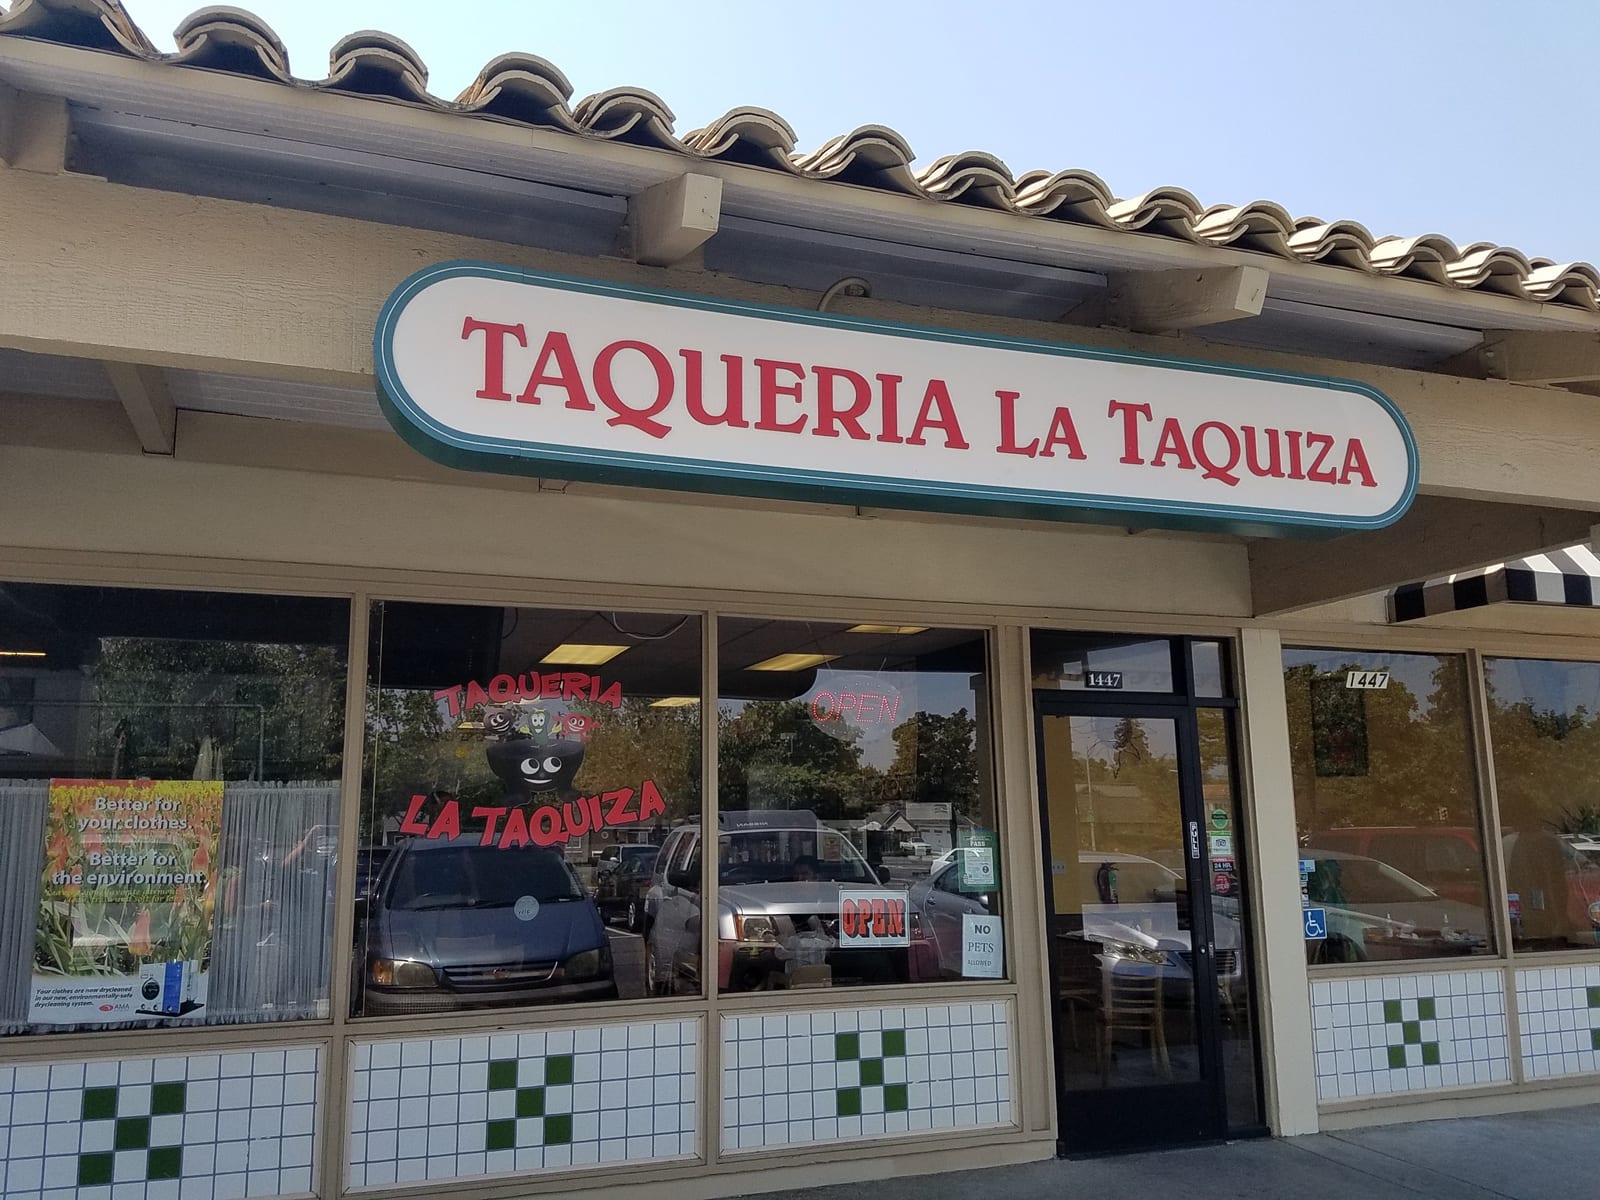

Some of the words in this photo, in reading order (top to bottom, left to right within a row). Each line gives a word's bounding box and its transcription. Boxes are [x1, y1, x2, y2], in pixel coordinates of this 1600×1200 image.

[462, 316, 969, 449] TAQUERIA
[995, 390, 1087, 460] LA
[1107, 400, 1377, 487] TAQUIZA
[1088, 673, 1121, 687] 1447
[1349, 672, 1388, 688] 1447
[434, 671, 622, 717] TAQUERIA
[811, 692, 899, 723] OPEN
[95, 798, 150, 811] Better
[155, 798, 182, 811] for
[400, 794, 461, 841] LA
[471, 779, 666, 849] TAQUIZA
[78, 818, 120, 832] your
[124, 816, 193, 830] clothes.
[89, 852, 146, 866] Better
[151, 852, 178, 866] for
[52, 871, 83, 885] the
[86, 870, 209, 886] environment.
[842, 898, 905, 939] OPEN
[974, 924, 991, 935] NO
[968, 941, 994, 953] PETS
[967, 959, 992, 967] ALLOWED
[99, 986, 132, 994] drycleaned
[34, 1001, 70, 1009] drycleaning
